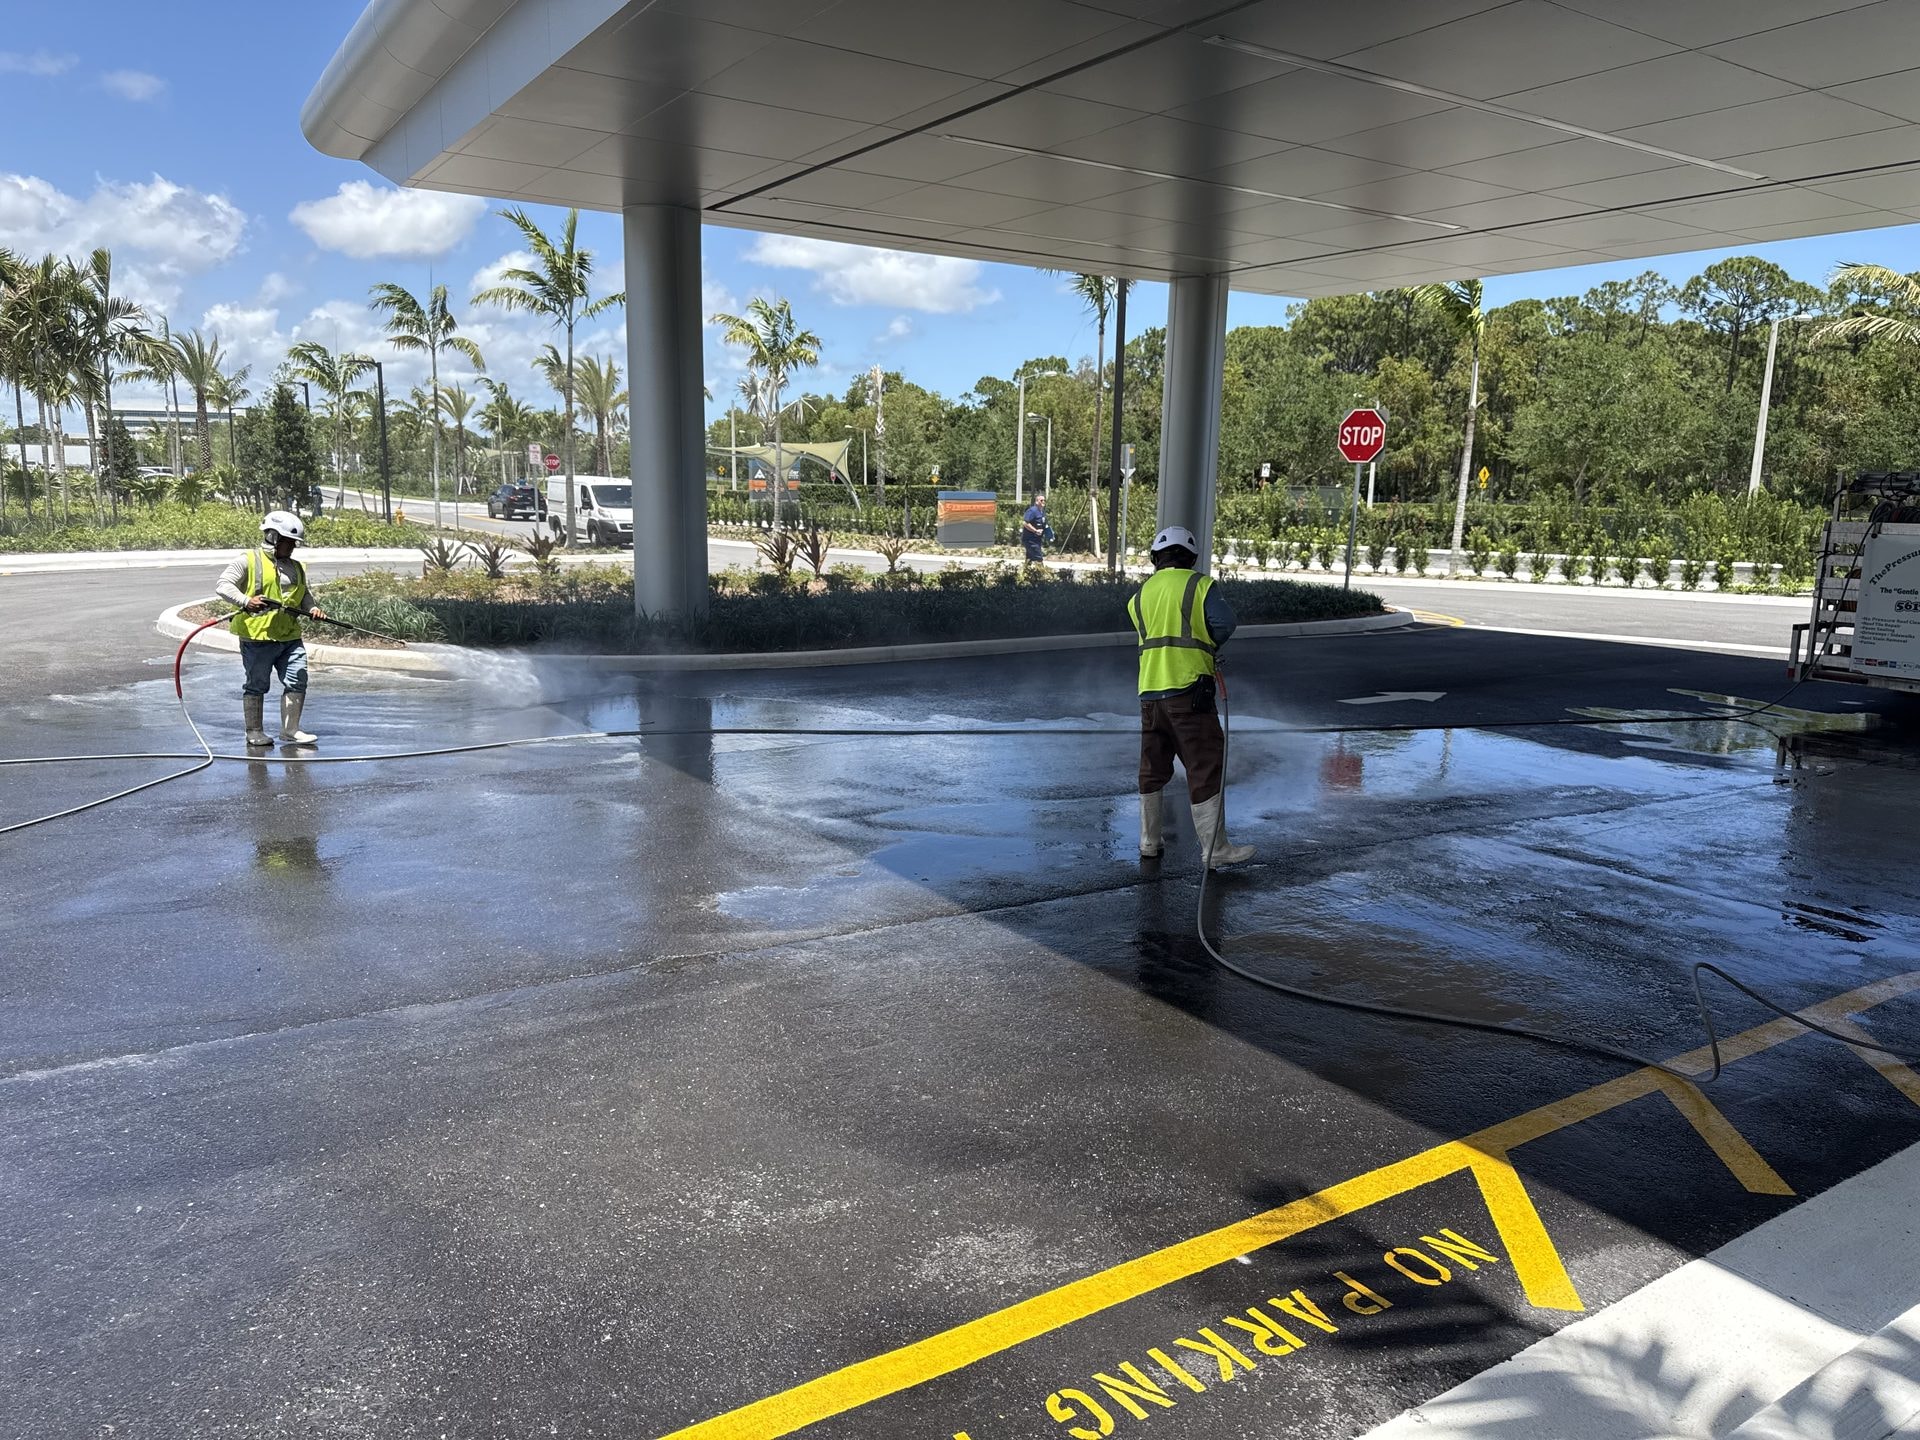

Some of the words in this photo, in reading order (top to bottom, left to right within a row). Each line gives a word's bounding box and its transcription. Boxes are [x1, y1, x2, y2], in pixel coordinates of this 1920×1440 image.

[1341, 426, 1382, 446] STOP
[1895, 600, 1920, 612] 561
[1384, 1228, 1499, 1286] NO
[1045, 1271, 1394, 1440] PARKING
